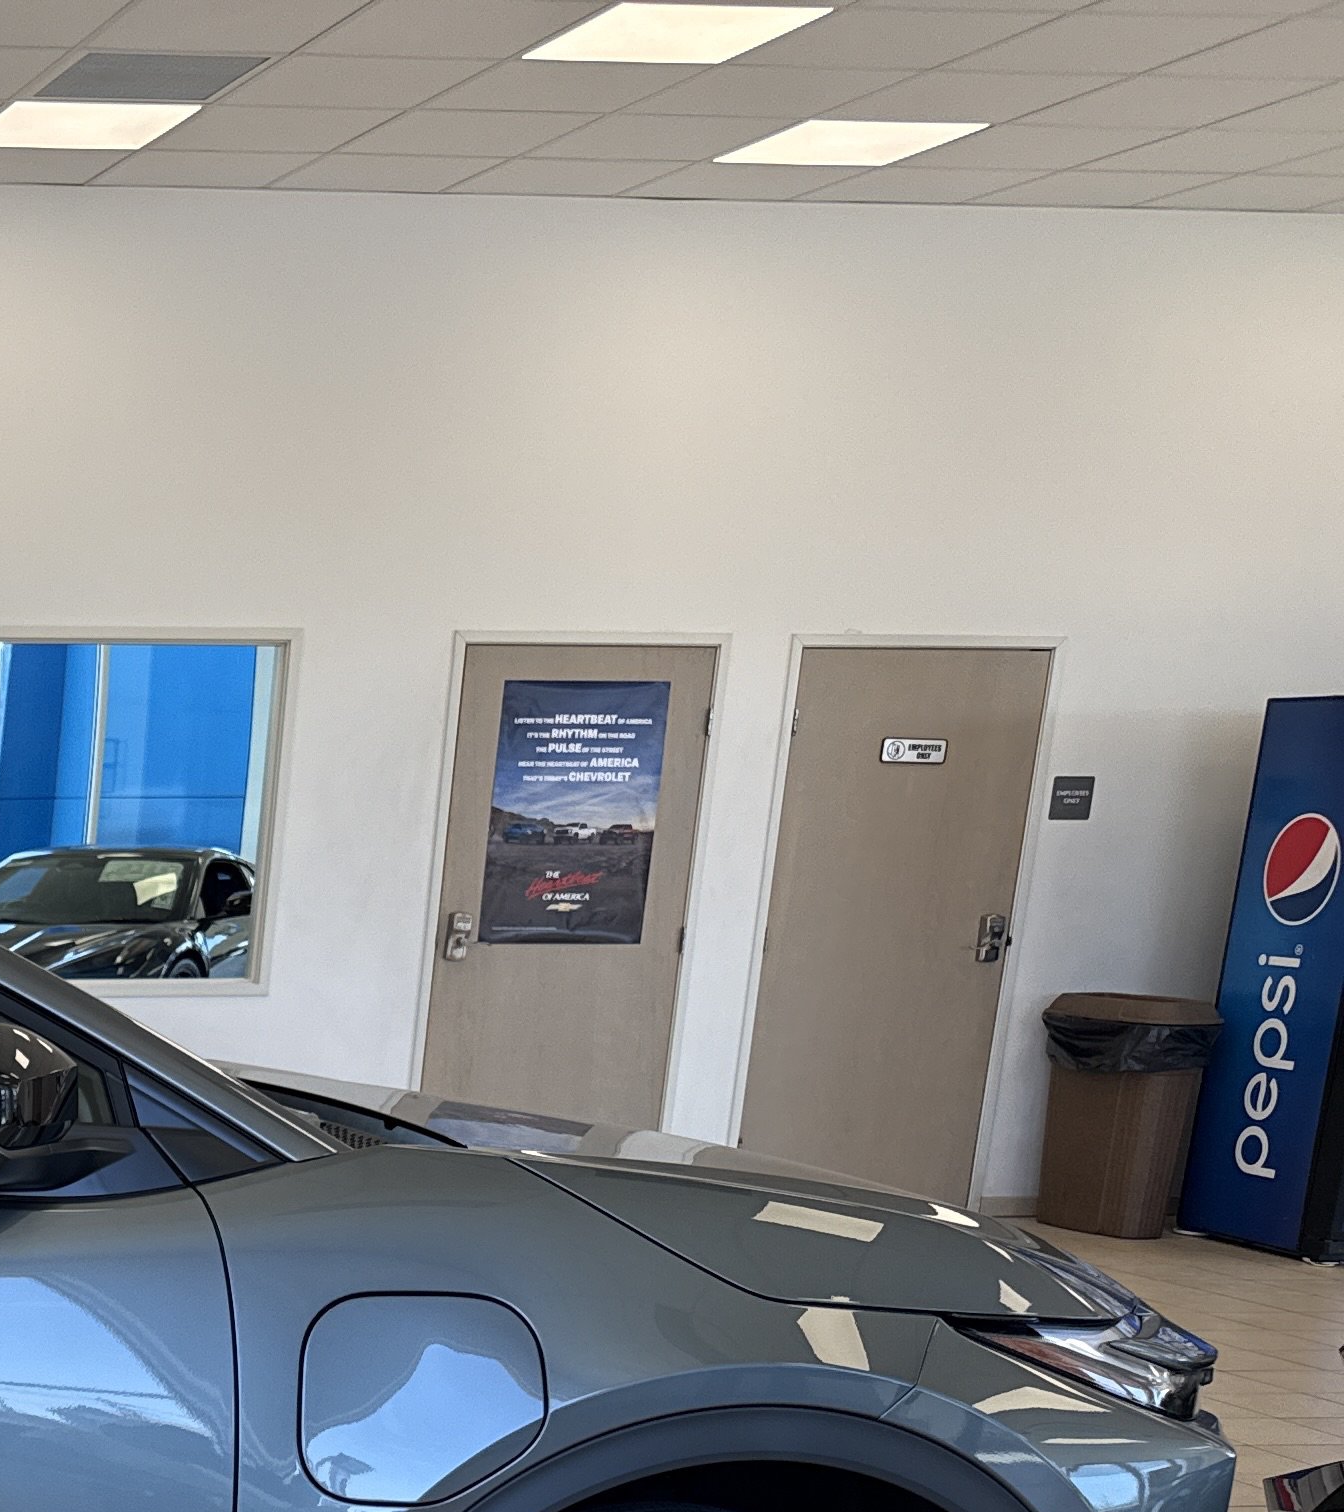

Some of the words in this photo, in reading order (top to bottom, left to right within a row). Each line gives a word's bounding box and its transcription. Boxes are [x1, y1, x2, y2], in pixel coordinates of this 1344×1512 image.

[555, 714, 618, 725] HEARTBEAT
[551, 728, 598, 739] RHYTHM
[548, 743, 582, 753] PULSE
[908, 744, 942, 752] EMPLOYEES
[916, 752, 931, 760] ONLY
[590, 757, 639, 768] AMERICA
[568, 771, 631, 782] CHEVROLET
[545, 870, 560, 878] THE
[553, 892, 590, 900] AMERICA
[1234, 953, 1301, 1179] pepsi
